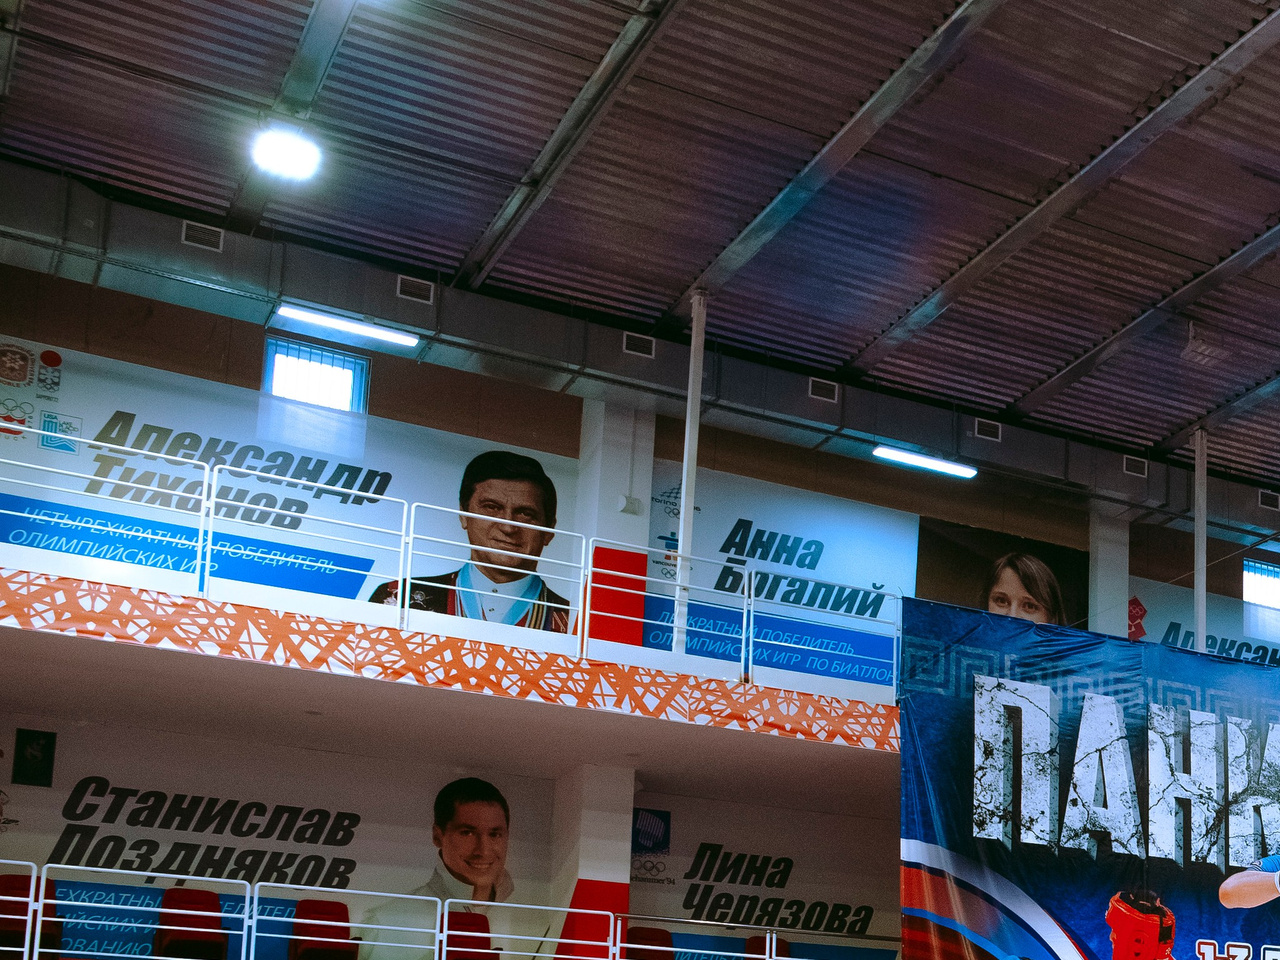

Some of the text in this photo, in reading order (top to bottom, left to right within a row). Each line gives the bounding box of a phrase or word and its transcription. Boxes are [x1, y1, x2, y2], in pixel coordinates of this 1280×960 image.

[87, 409, 393, 505] Александр
[83, 454, 309, 531] Тихонов
[8, 529, 178, 569] ОЛИМПИЙСКИХ
[213, 541, 338, 575] ПОБЕДИТЕЛЬ
[652, 559, 678, 568] vancouve
[718, 517, 825, 570] Анна
[713, 556, 886, 618] Богалий
[649, 630, 771, 661] ОЛМПИЙСКИХ
[772, 651, 801, 666] ИГР
[806, 656, 829, 671] ПО
[759, 628, 855, 655] ПОБЕДИТЕЛЬ
[61, 775, 361, 847] Станислав
[46, 823, 357, 890] Поздняков
[683, 842, 794, 889] Лина
[682, 883, 875, 935] Черязова
